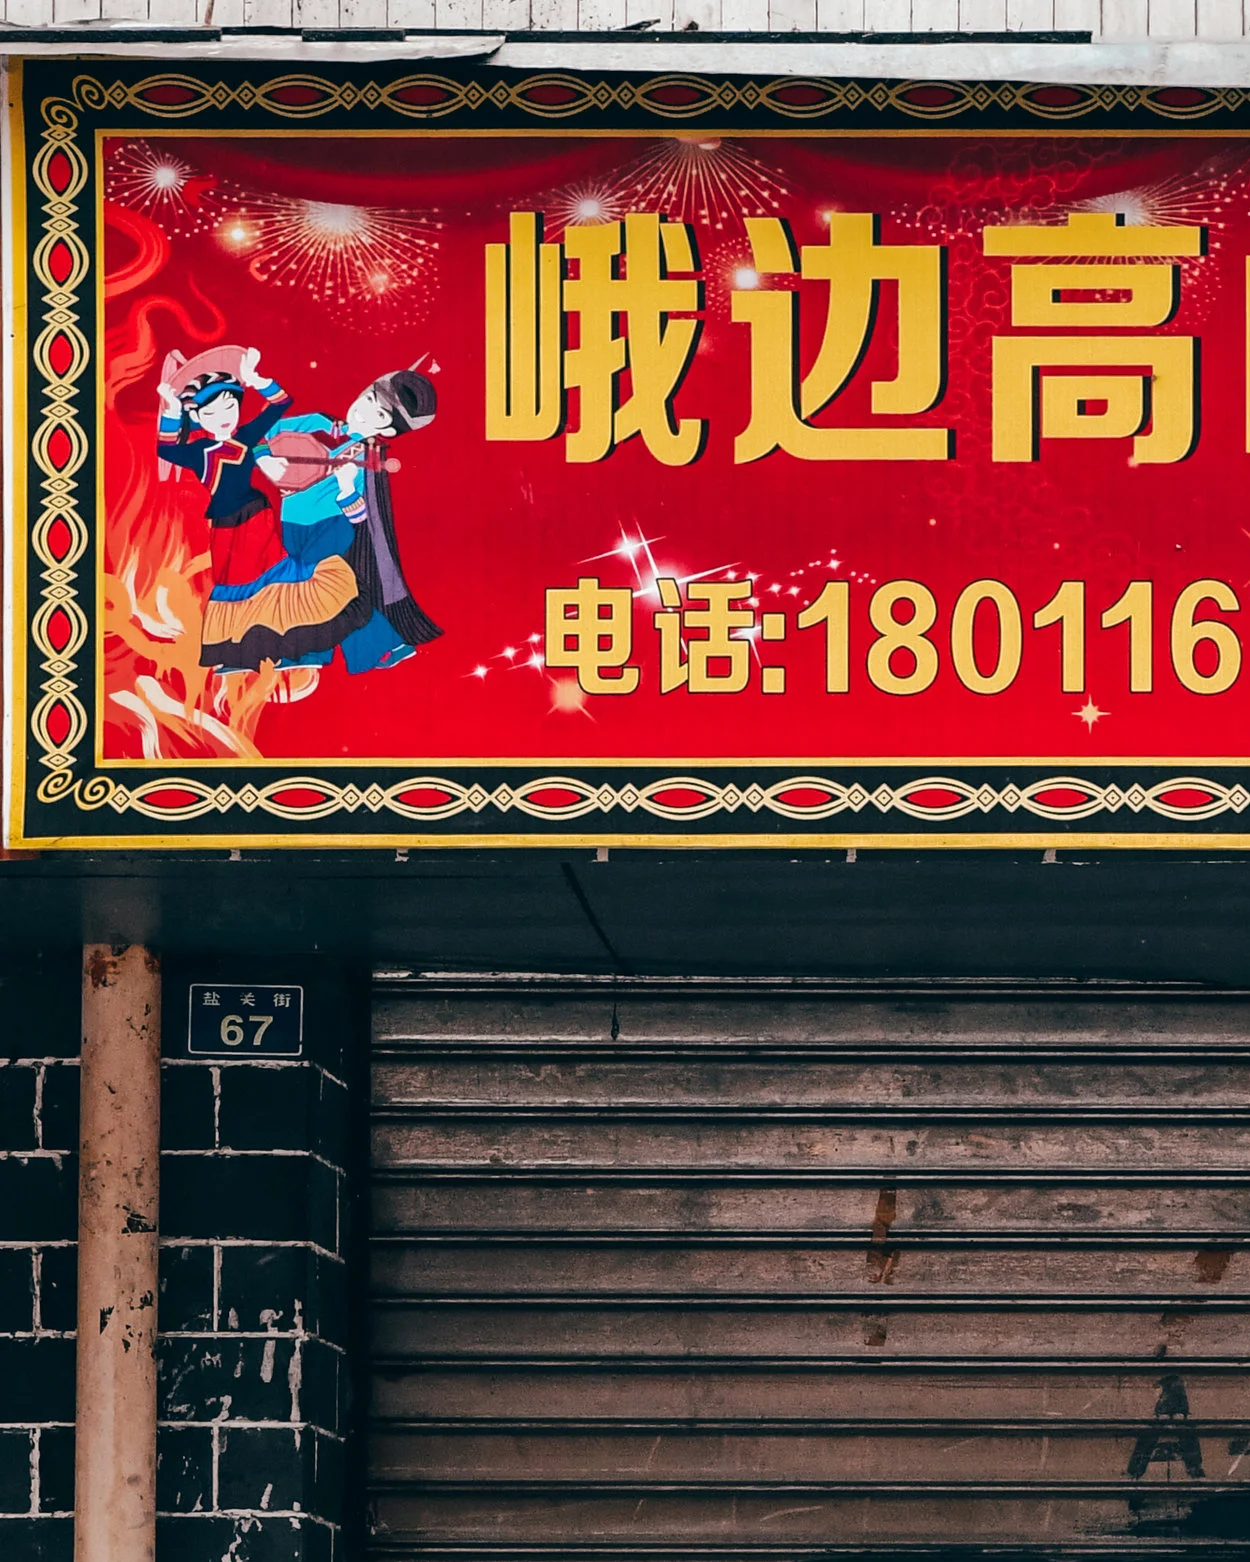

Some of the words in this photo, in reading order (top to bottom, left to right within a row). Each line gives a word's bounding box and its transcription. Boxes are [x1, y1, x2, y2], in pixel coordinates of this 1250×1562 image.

[202, 991, 292, 1008] 盐关街
[219, 1014, 275, 1046] 67
